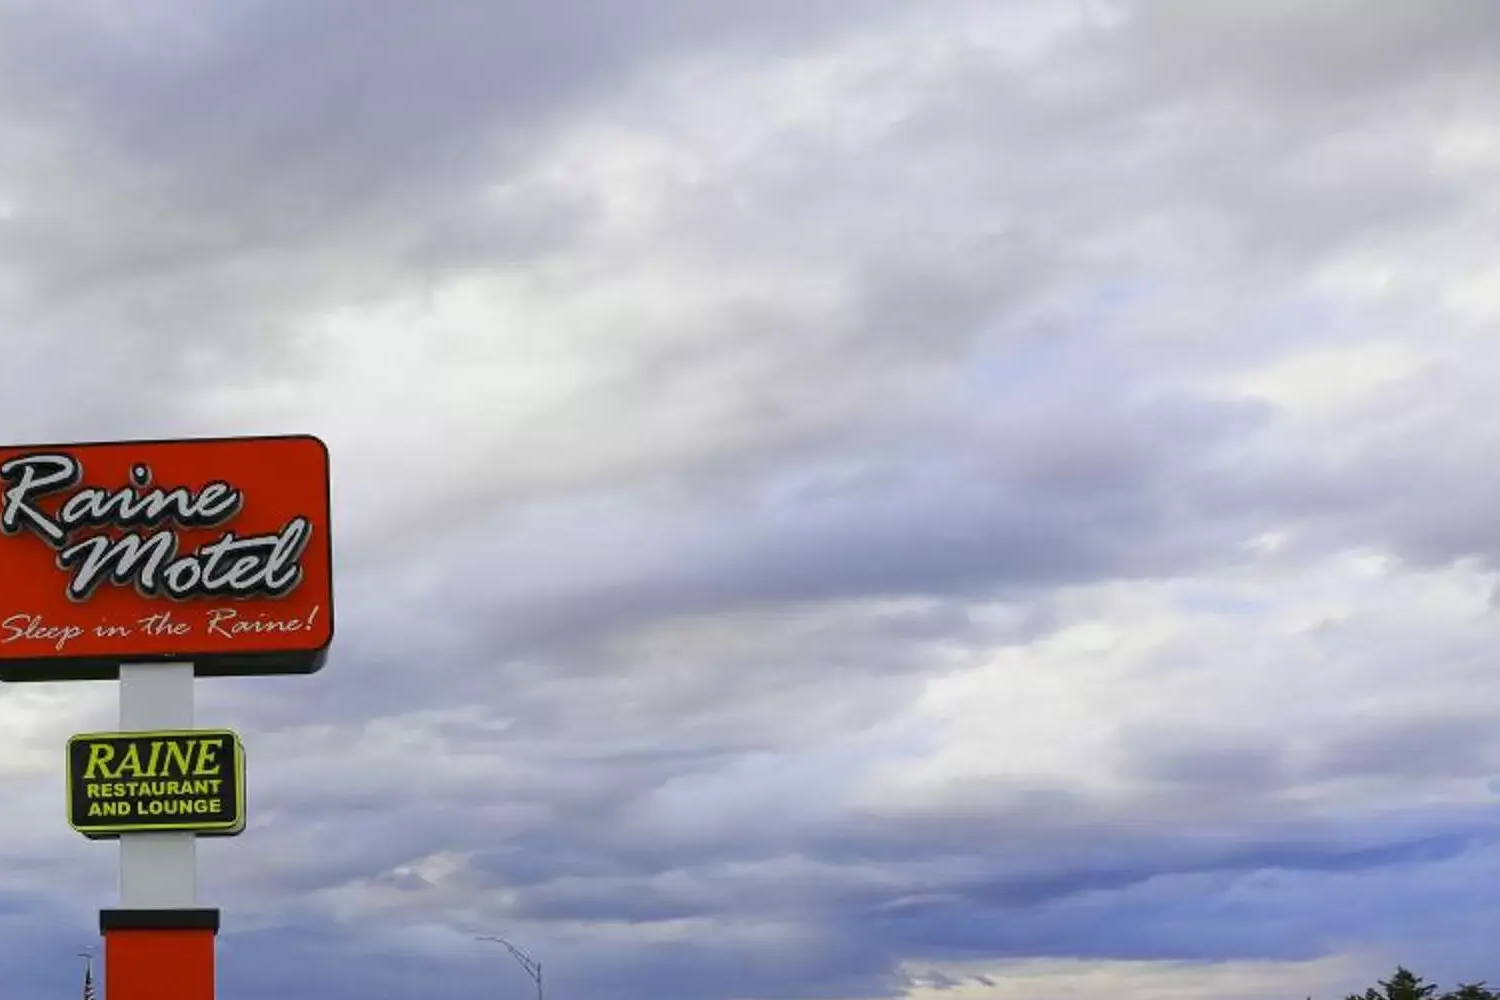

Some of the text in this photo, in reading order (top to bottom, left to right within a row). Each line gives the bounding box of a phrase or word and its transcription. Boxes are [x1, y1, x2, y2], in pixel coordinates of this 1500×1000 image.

[0, 453, 240, 542] Raine
[60, 516, 309, 597] Motel
[1, 604, 320, 650] Sleep in the Raine!
[83, 739, 222, 779] RAINE
[86, 780, 223, 798] RESTAURANT
[88, 799, 221, 816] AND LOUNGE
